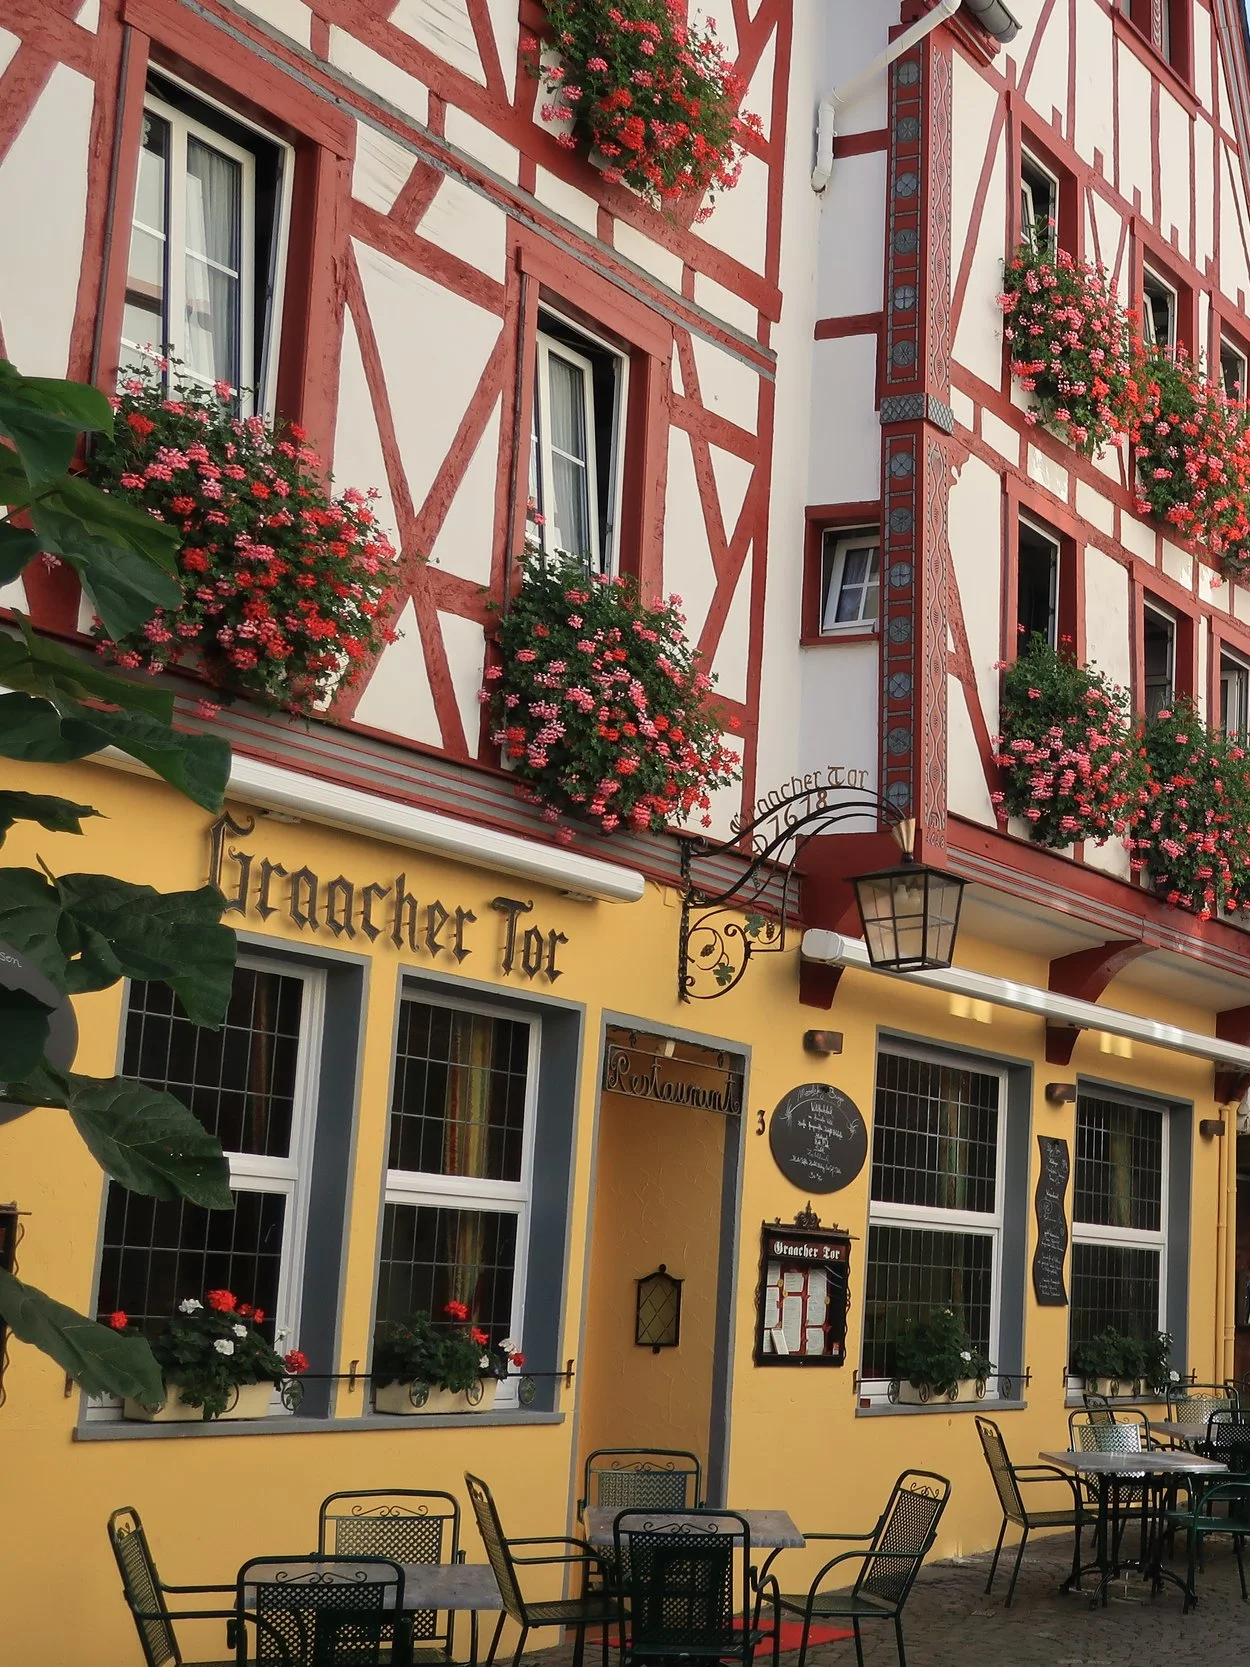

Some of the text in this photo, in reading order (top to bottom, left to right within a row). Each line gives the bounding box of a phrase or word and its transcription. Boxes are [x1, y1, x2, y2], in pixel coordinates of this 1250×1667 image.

[827, 765, 869, 788] Tor
[205, 810, 569, 984] Graacher Tor
[609, 1050, 741, 1114] Restaurant
[755, 1109, 766, 1136] 3
[774, 1241, 840, 1260] Graacher Tor
